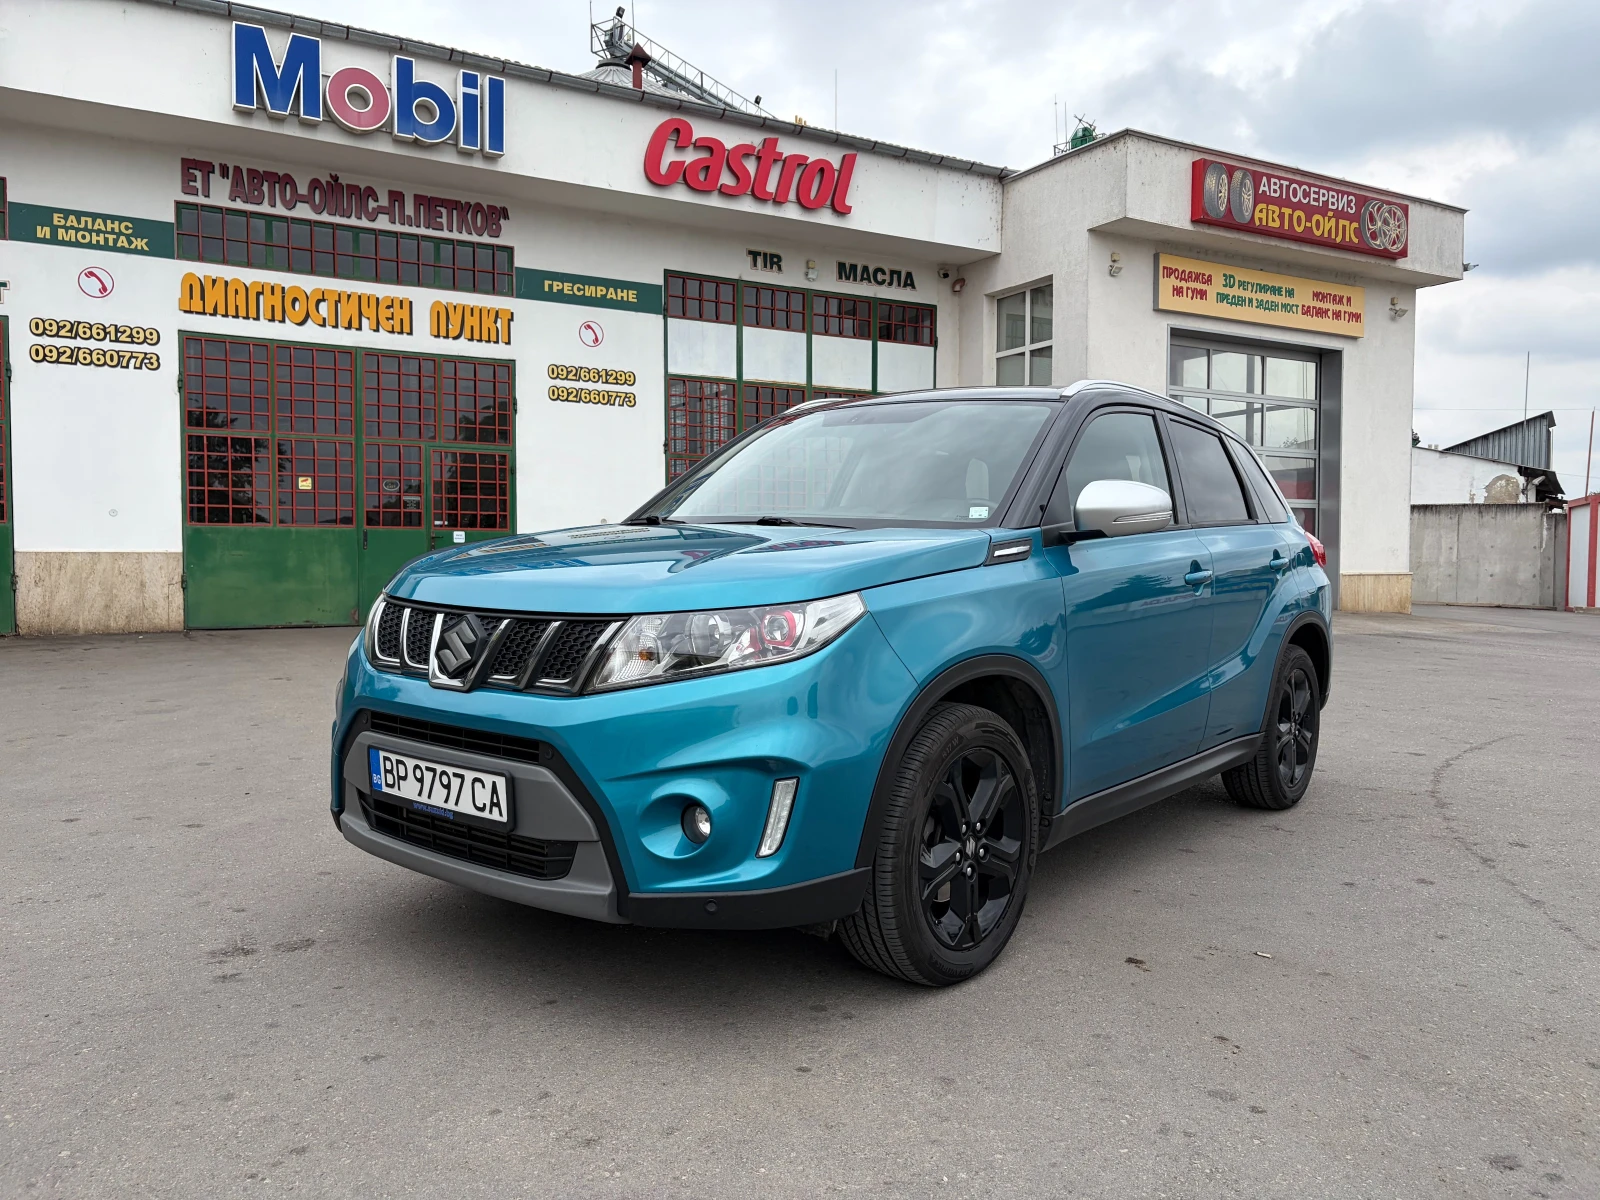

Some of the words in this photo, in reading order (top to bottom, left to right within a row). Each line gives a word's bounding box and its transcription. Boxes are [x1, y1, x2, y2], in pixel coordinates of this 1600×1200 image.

[232, 21, 506, 158] Mobil
[181, 157, 214, 198] ЕТ
[644, 117, 858, 215] Castrol
[1259, 176, 1356, 214] АВТОСЕРВИЗ
[53, 213, 133, 234] БАЛАНС
[1254, 203, 1360, 243] АВТО-ОЙЛС
[36, 225, 50, 239] И
[57, 228, 149, 250] МОНТАЖ
[746, 249, 783, 273] TIR
[836, 260, 917, 291] МАСЛА
[1162, 265, 1213, 286] ПРОДАЖБА
[1222, 273, 1236, 289] 3D
[1237, 279, 1283, 297] РЕГУЛИРАНЕ
[1284, 287, 1295, 299] НА
[544, 279, 638, 303] ГРЕСИРАНЕ
[1172, 284, 1184, 299] НА
[1185, 286, 1208, 301] ГУМИ
[1215, 291, 1247, 308] ПРЕДЕН
[1247, 297, 1254, 308] И
[1255, 298, 1279, 312] ЗАДЕН
[1280, 301, 1300, 315] МОСТ
[1312, 290, 1345, 307] МОНТАЖ
[1346, 295, 1352, 308] И
[178, 272, 413, 335] ДИАГНОСТИЧЕН
[429, 299, 514, 345] ПУНКТ
[1301, 303, 1331, 320] БАЛАНС
[1331, 308, 1342, 321] НА
[1343, 310, 1362, 324] ГУМИ
[29, 317, 161, 346] 092/661299
[29, 344, 161, 371] 092/660773
[547, 363, 636, 386] 092/661299
[548, 385, 637, 408] 092/660773
[372, 773, 382, 785] BG
[412, 763, 466, 807] 9797
